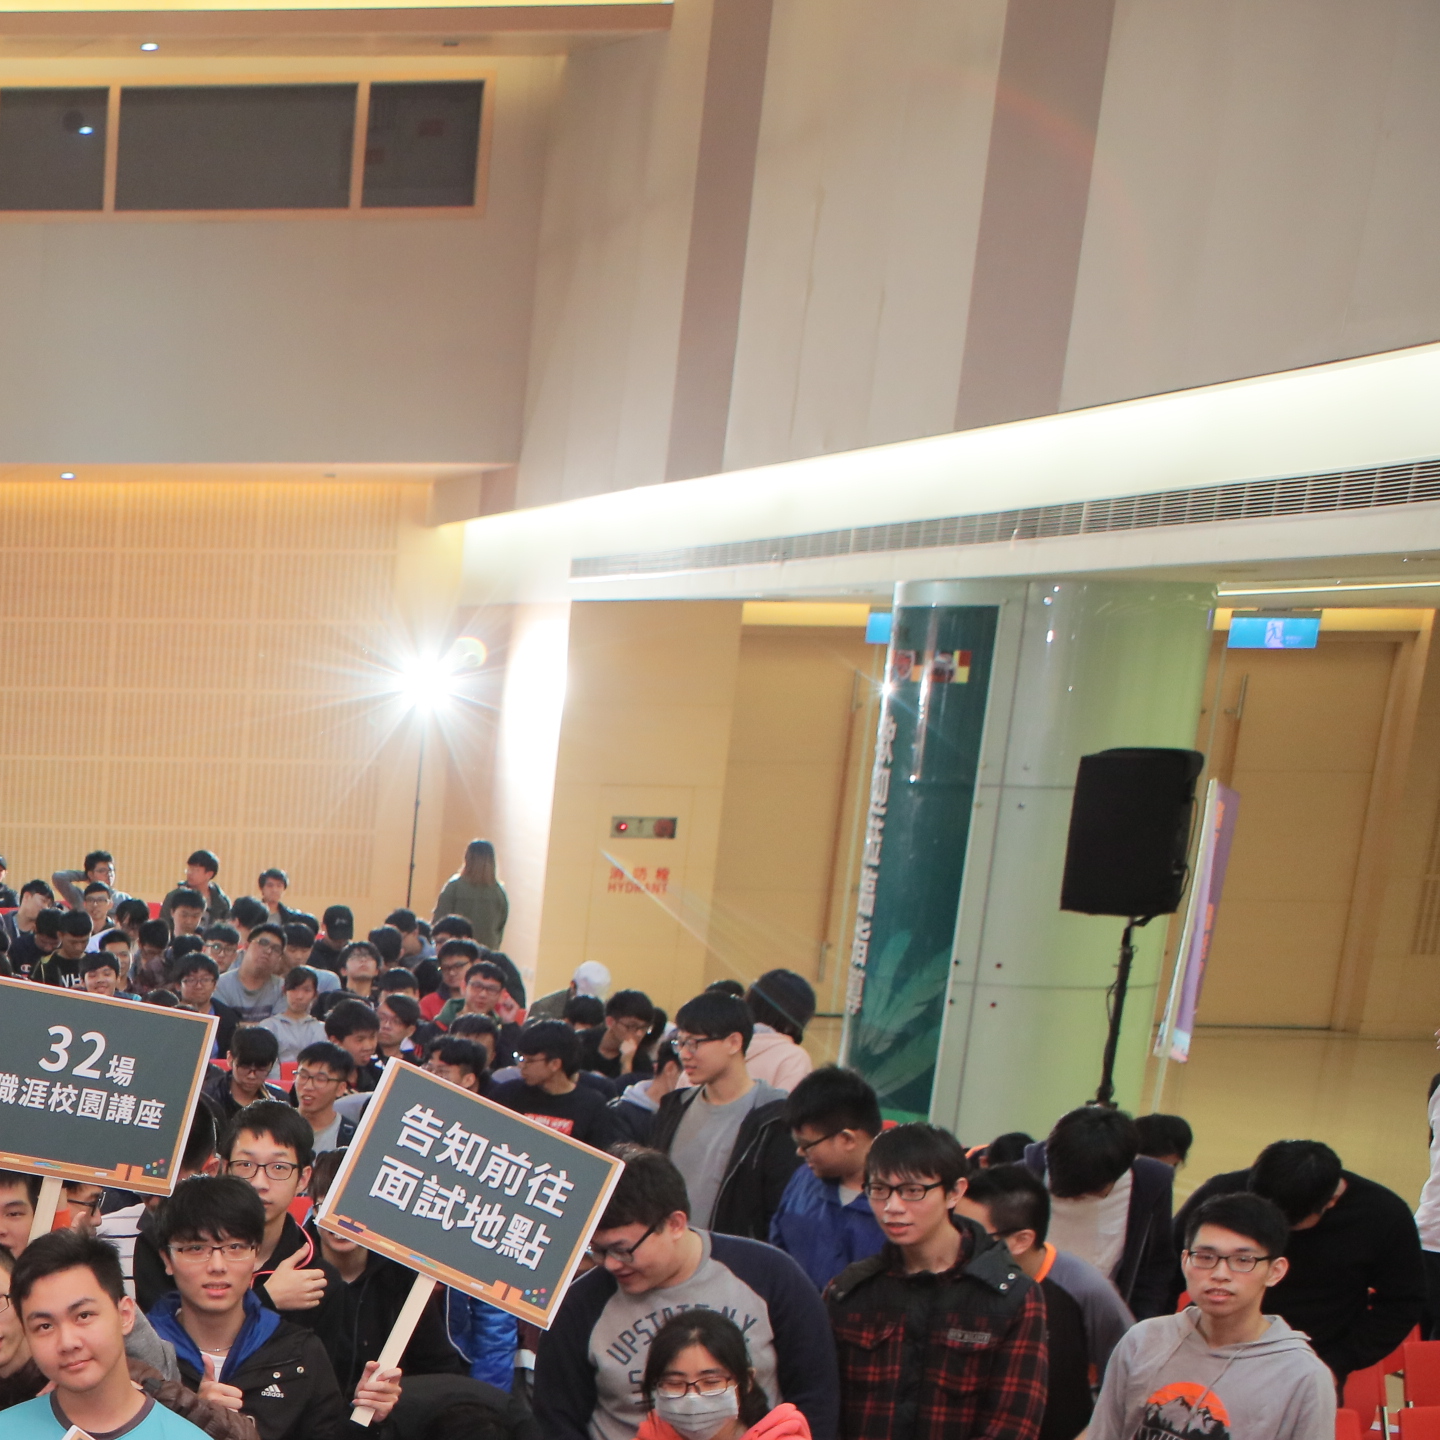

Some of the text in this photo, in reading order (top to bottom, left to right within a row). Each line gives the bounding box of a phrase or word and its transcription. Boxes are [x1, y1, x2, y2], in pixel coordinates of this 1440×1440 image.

[38, 1023, 136, 1088] 32場
[369, 1153, 554, 1272] 面試地點
[398, 1103, 576, 1217] 告知前往
